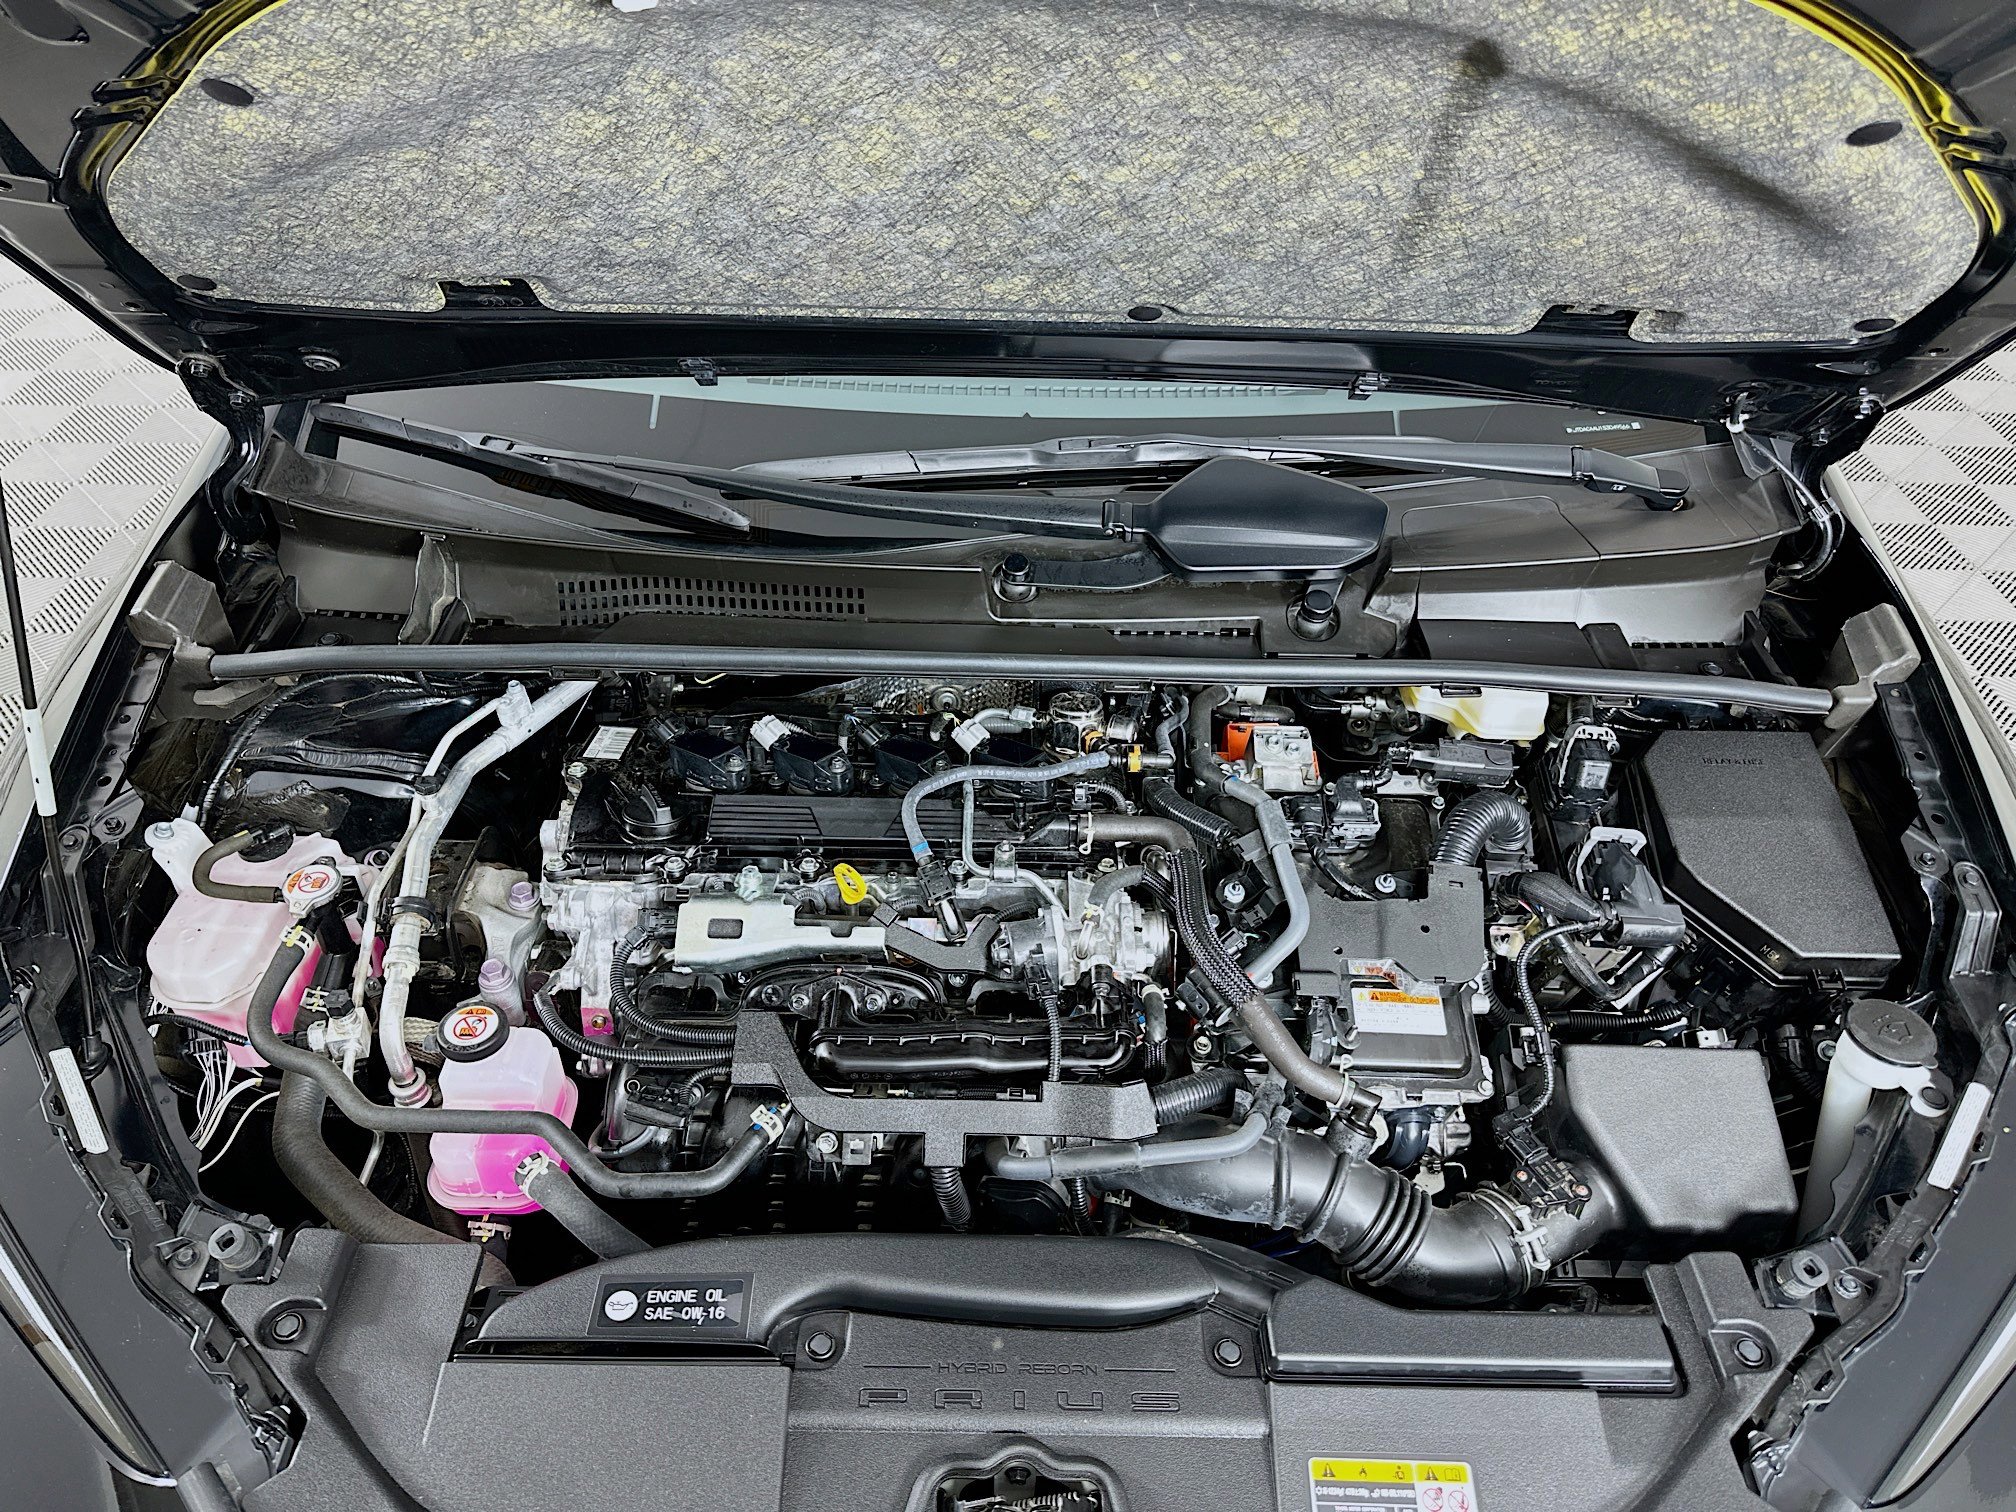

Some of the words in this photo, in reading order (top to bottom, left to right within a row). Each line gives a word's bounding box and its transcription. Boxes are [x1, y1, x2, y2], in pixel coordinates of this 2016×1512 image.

[646, 1289, 698, 1304] ENGINE
[705, 1288, 728, 1303] OIL
[644, 1306, 675, 1321] SAE
[681, 1306, 726, 1321] 0W-16
[938, 1362, 1007, 1375] HYBRID
[1019, 1362, 1099, 1376] REBORN
[858, 1387, 1180, 1413] PRIUS
